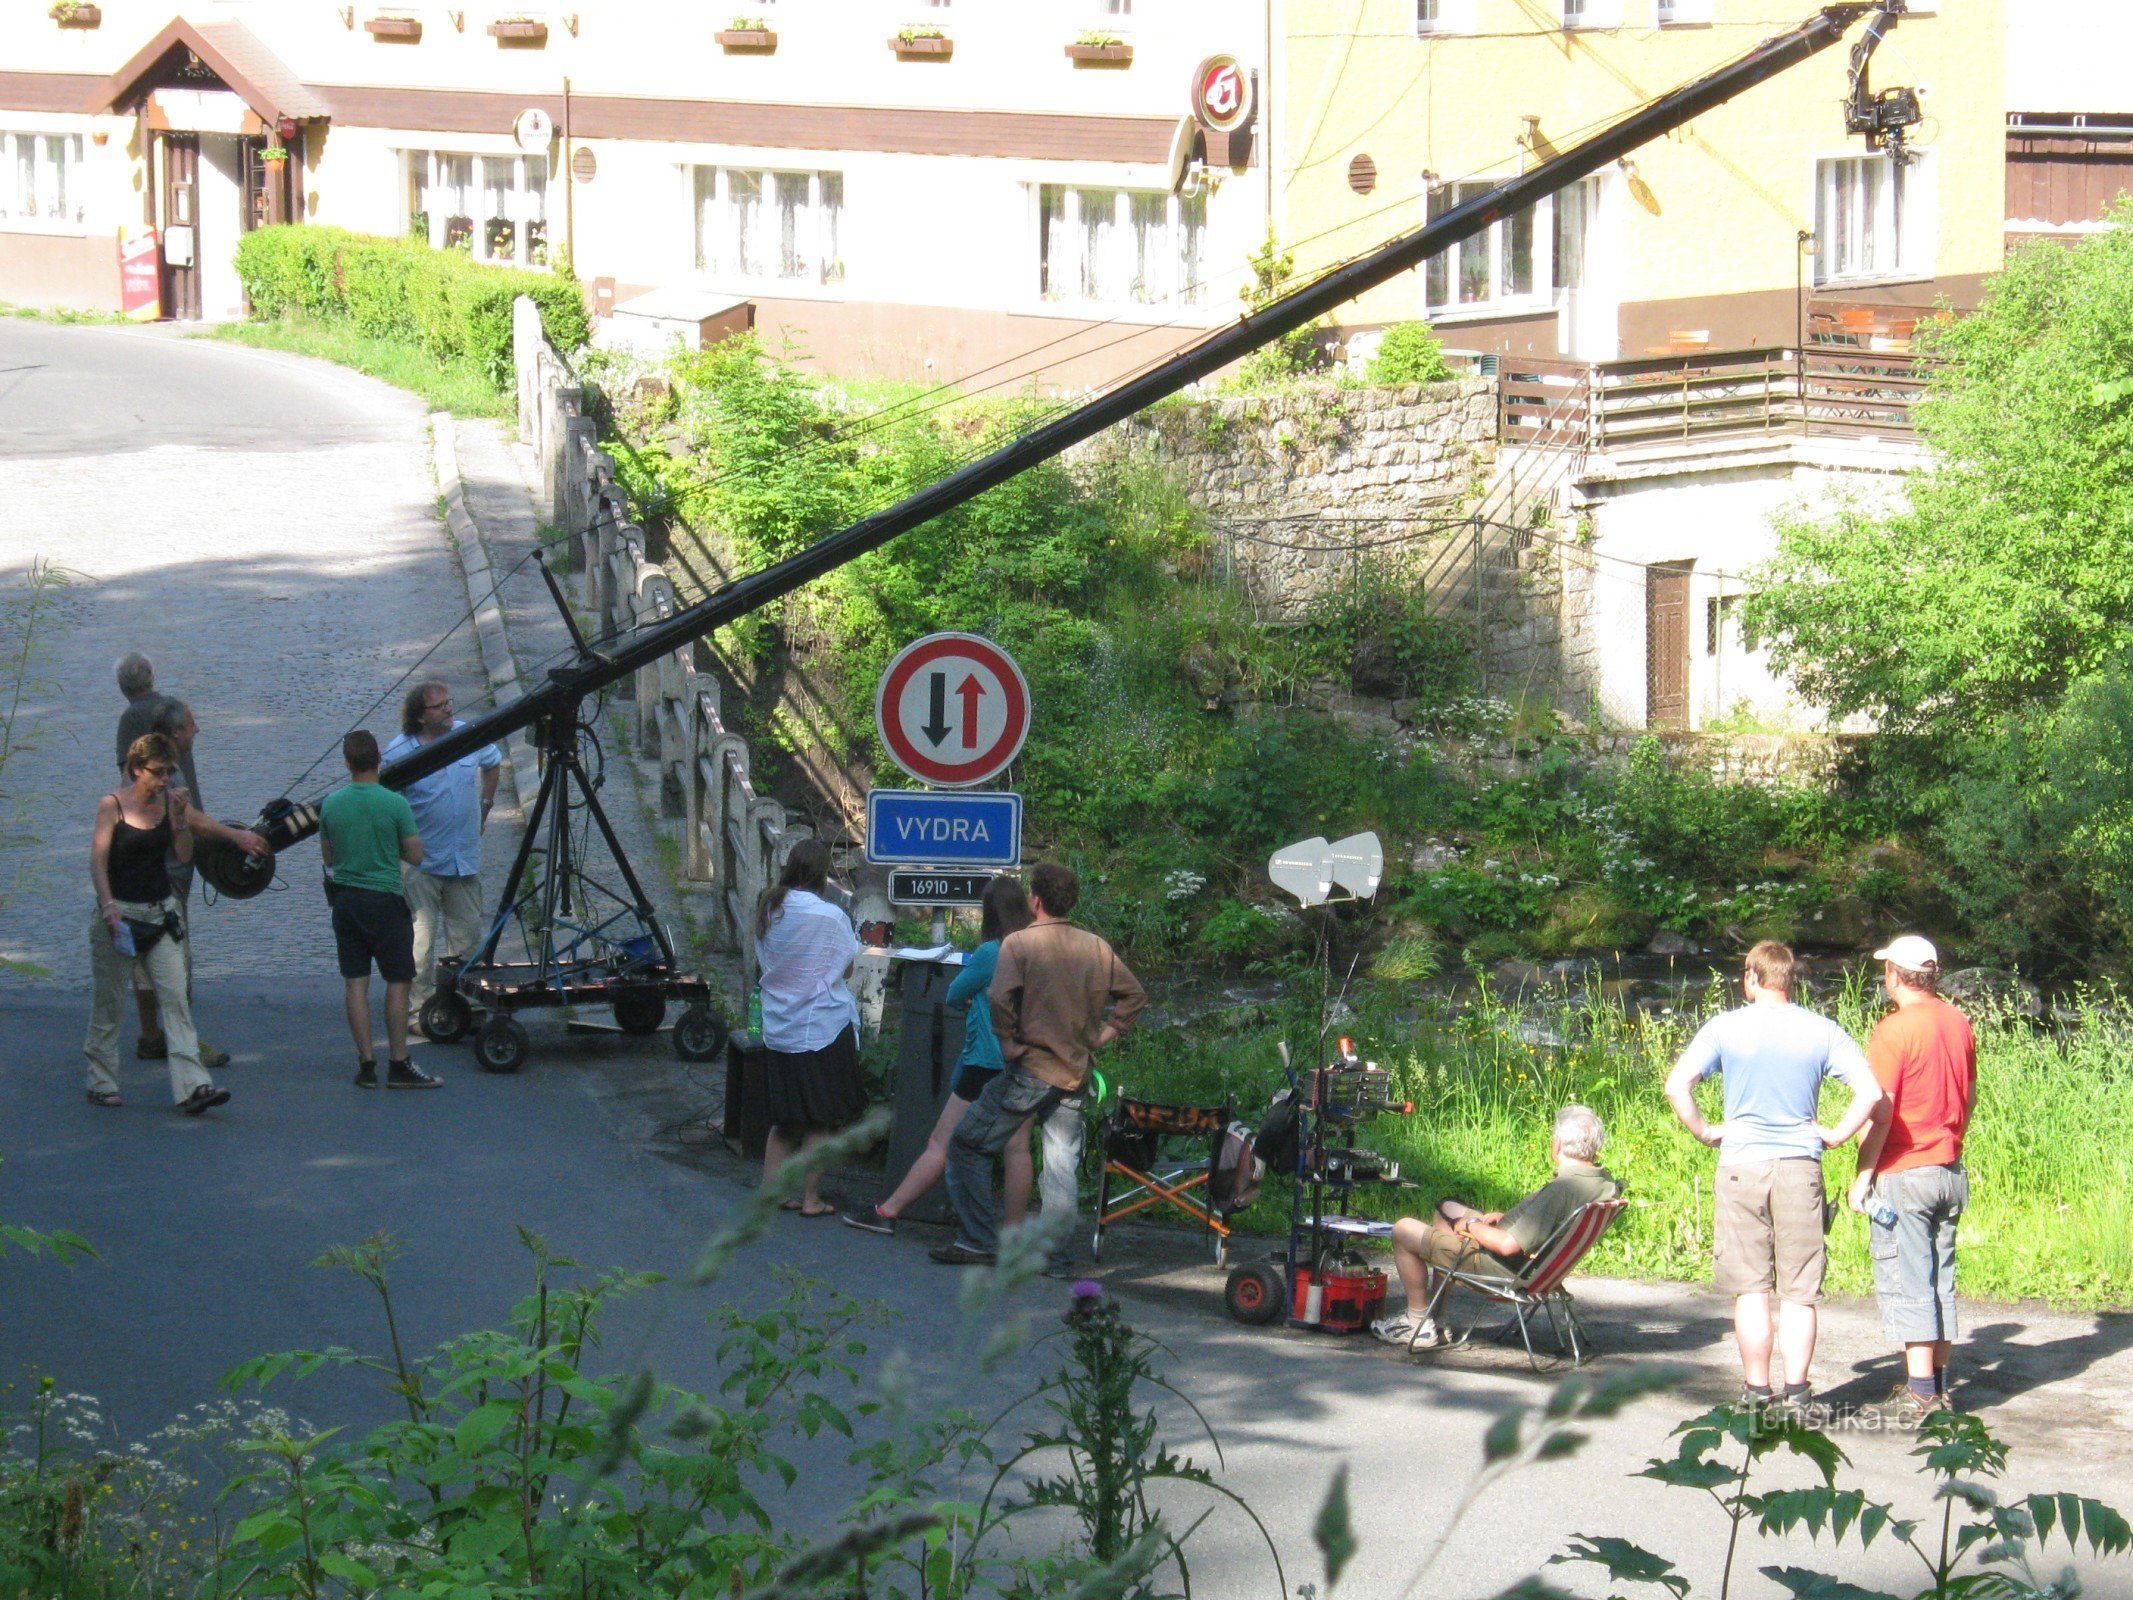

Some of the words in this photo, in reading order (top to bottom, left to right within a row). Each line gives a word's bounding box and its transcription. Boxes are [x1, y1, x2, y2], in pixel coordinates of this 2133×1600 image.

[896, 817, 990, 842] VYDRA
[911, 880, 948, 895] 16910
[966, 880, 973, 894] 1
